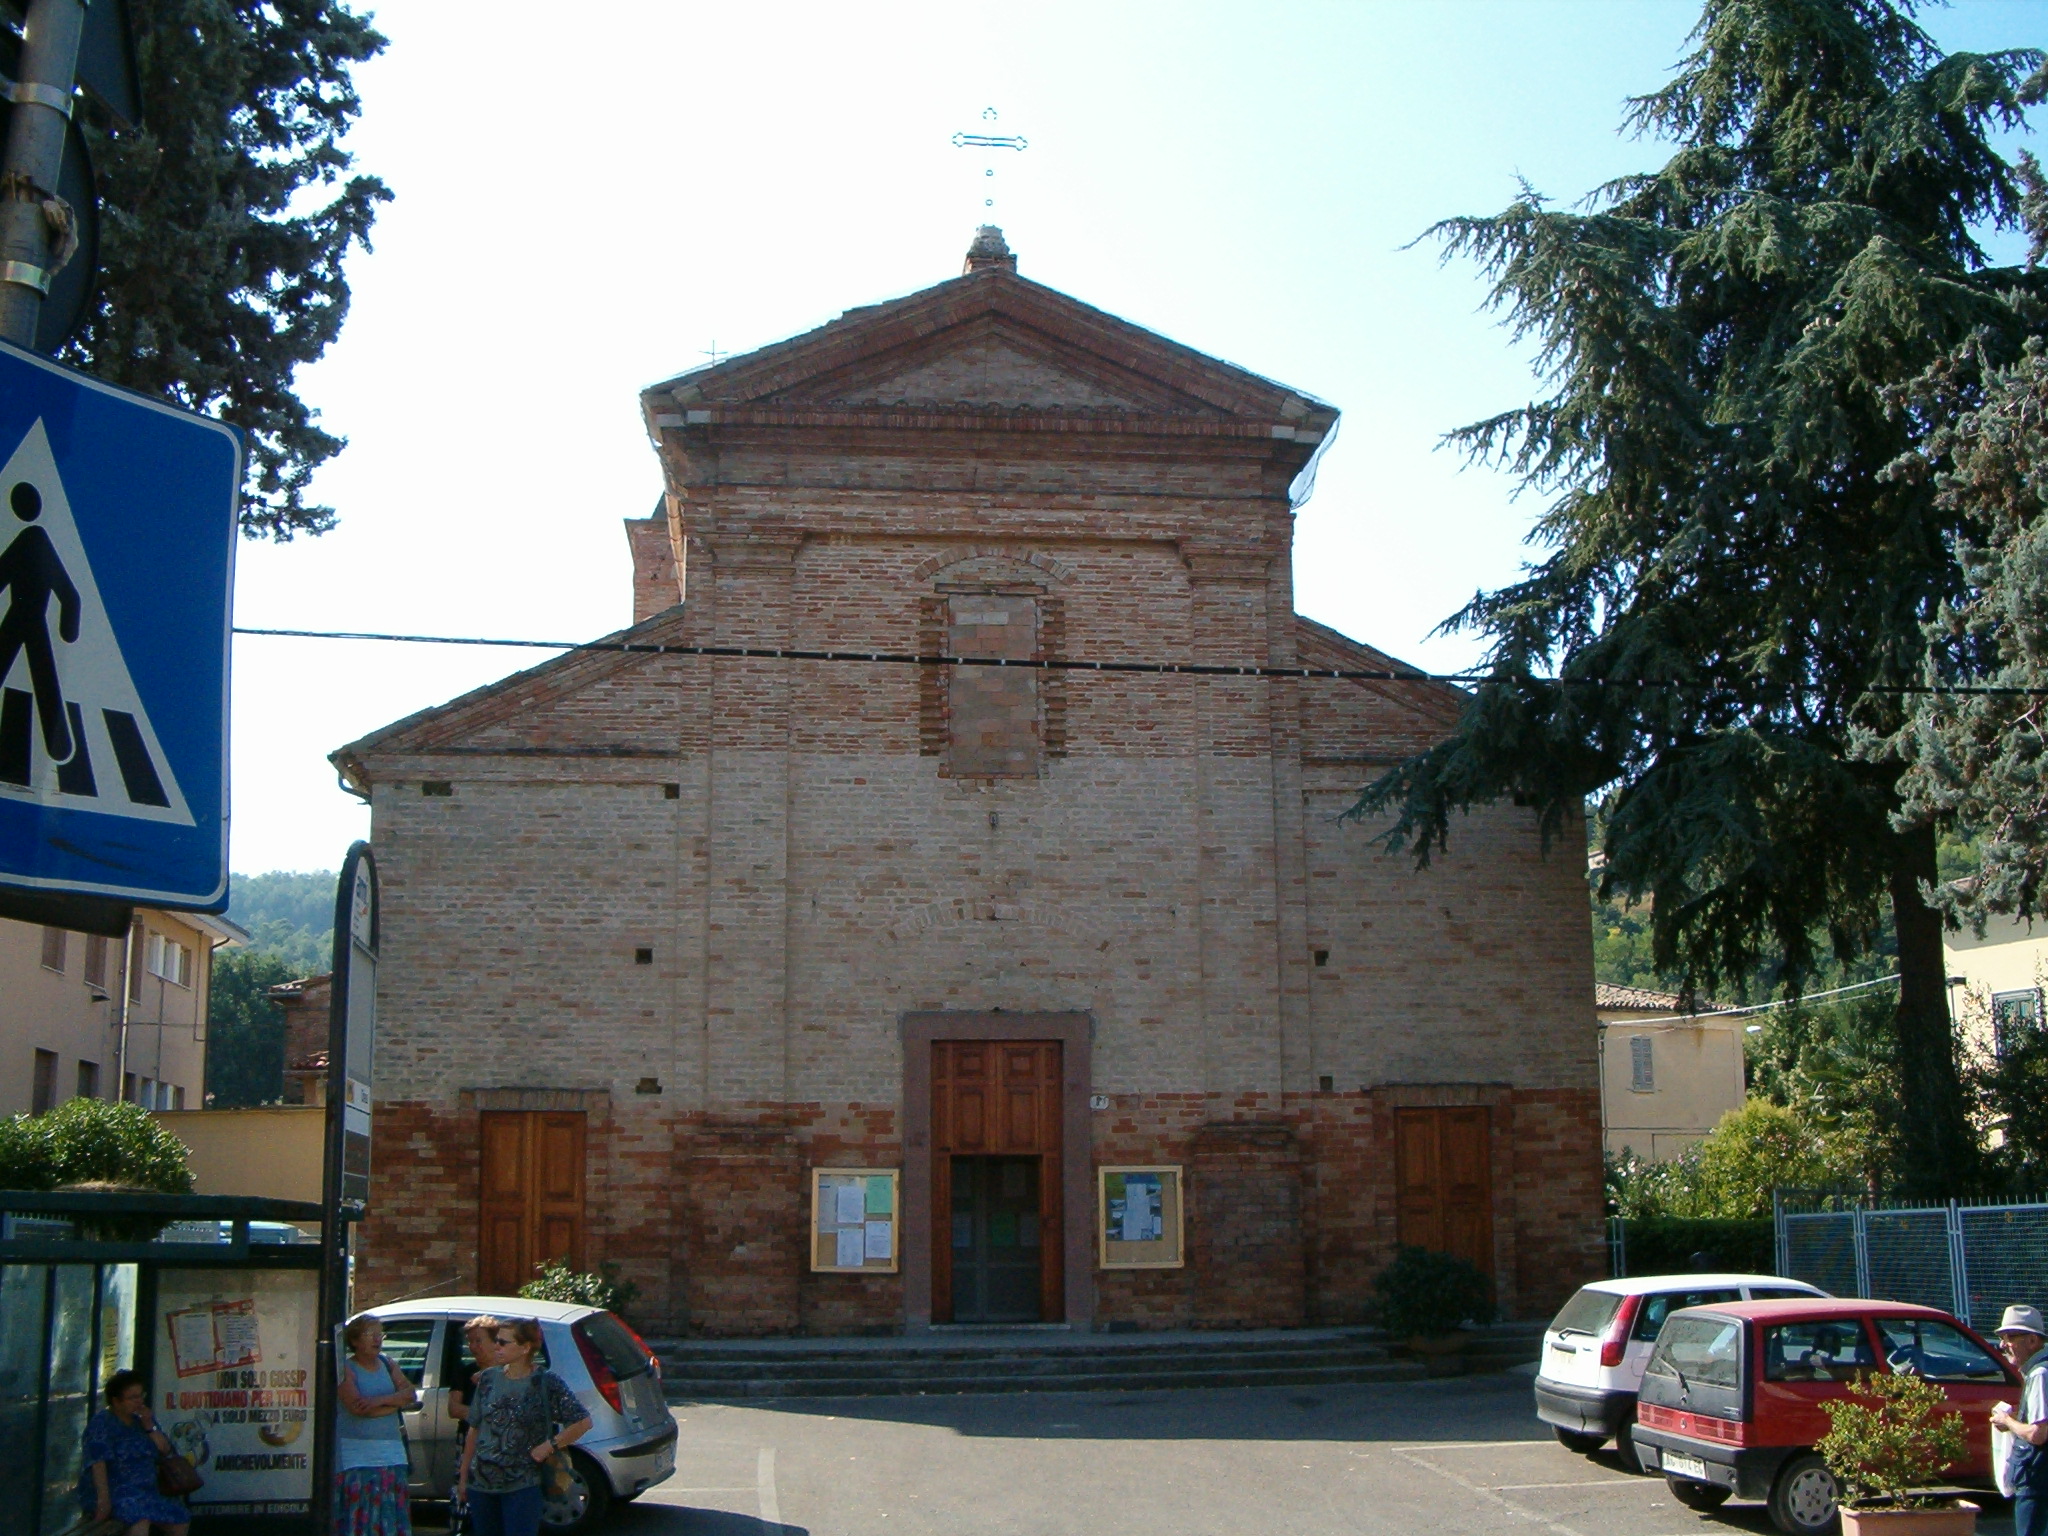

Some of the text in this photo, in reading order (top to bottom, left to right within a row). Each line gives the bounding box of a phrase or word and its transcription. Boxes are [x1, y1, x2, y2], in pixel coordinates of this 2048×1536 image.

[216, 1370, 307, 1389] NON SOLO GOSSIP
[180, 1391, 248, 1409] QUOTIDIANO
[251, 1390, 273, 1408] PER
[275, 1389, 307, 1407] TUTTI
[222, 1410, 247, 1423] SOLO
[248, 1410, 280, 1423] MEZZO
[282, 1410, 307, 1422] EURO
[215, 1453, 307, 1471] AMICHEVOLMENTE
[267, 1502, 310, 1513] EDICOLA
